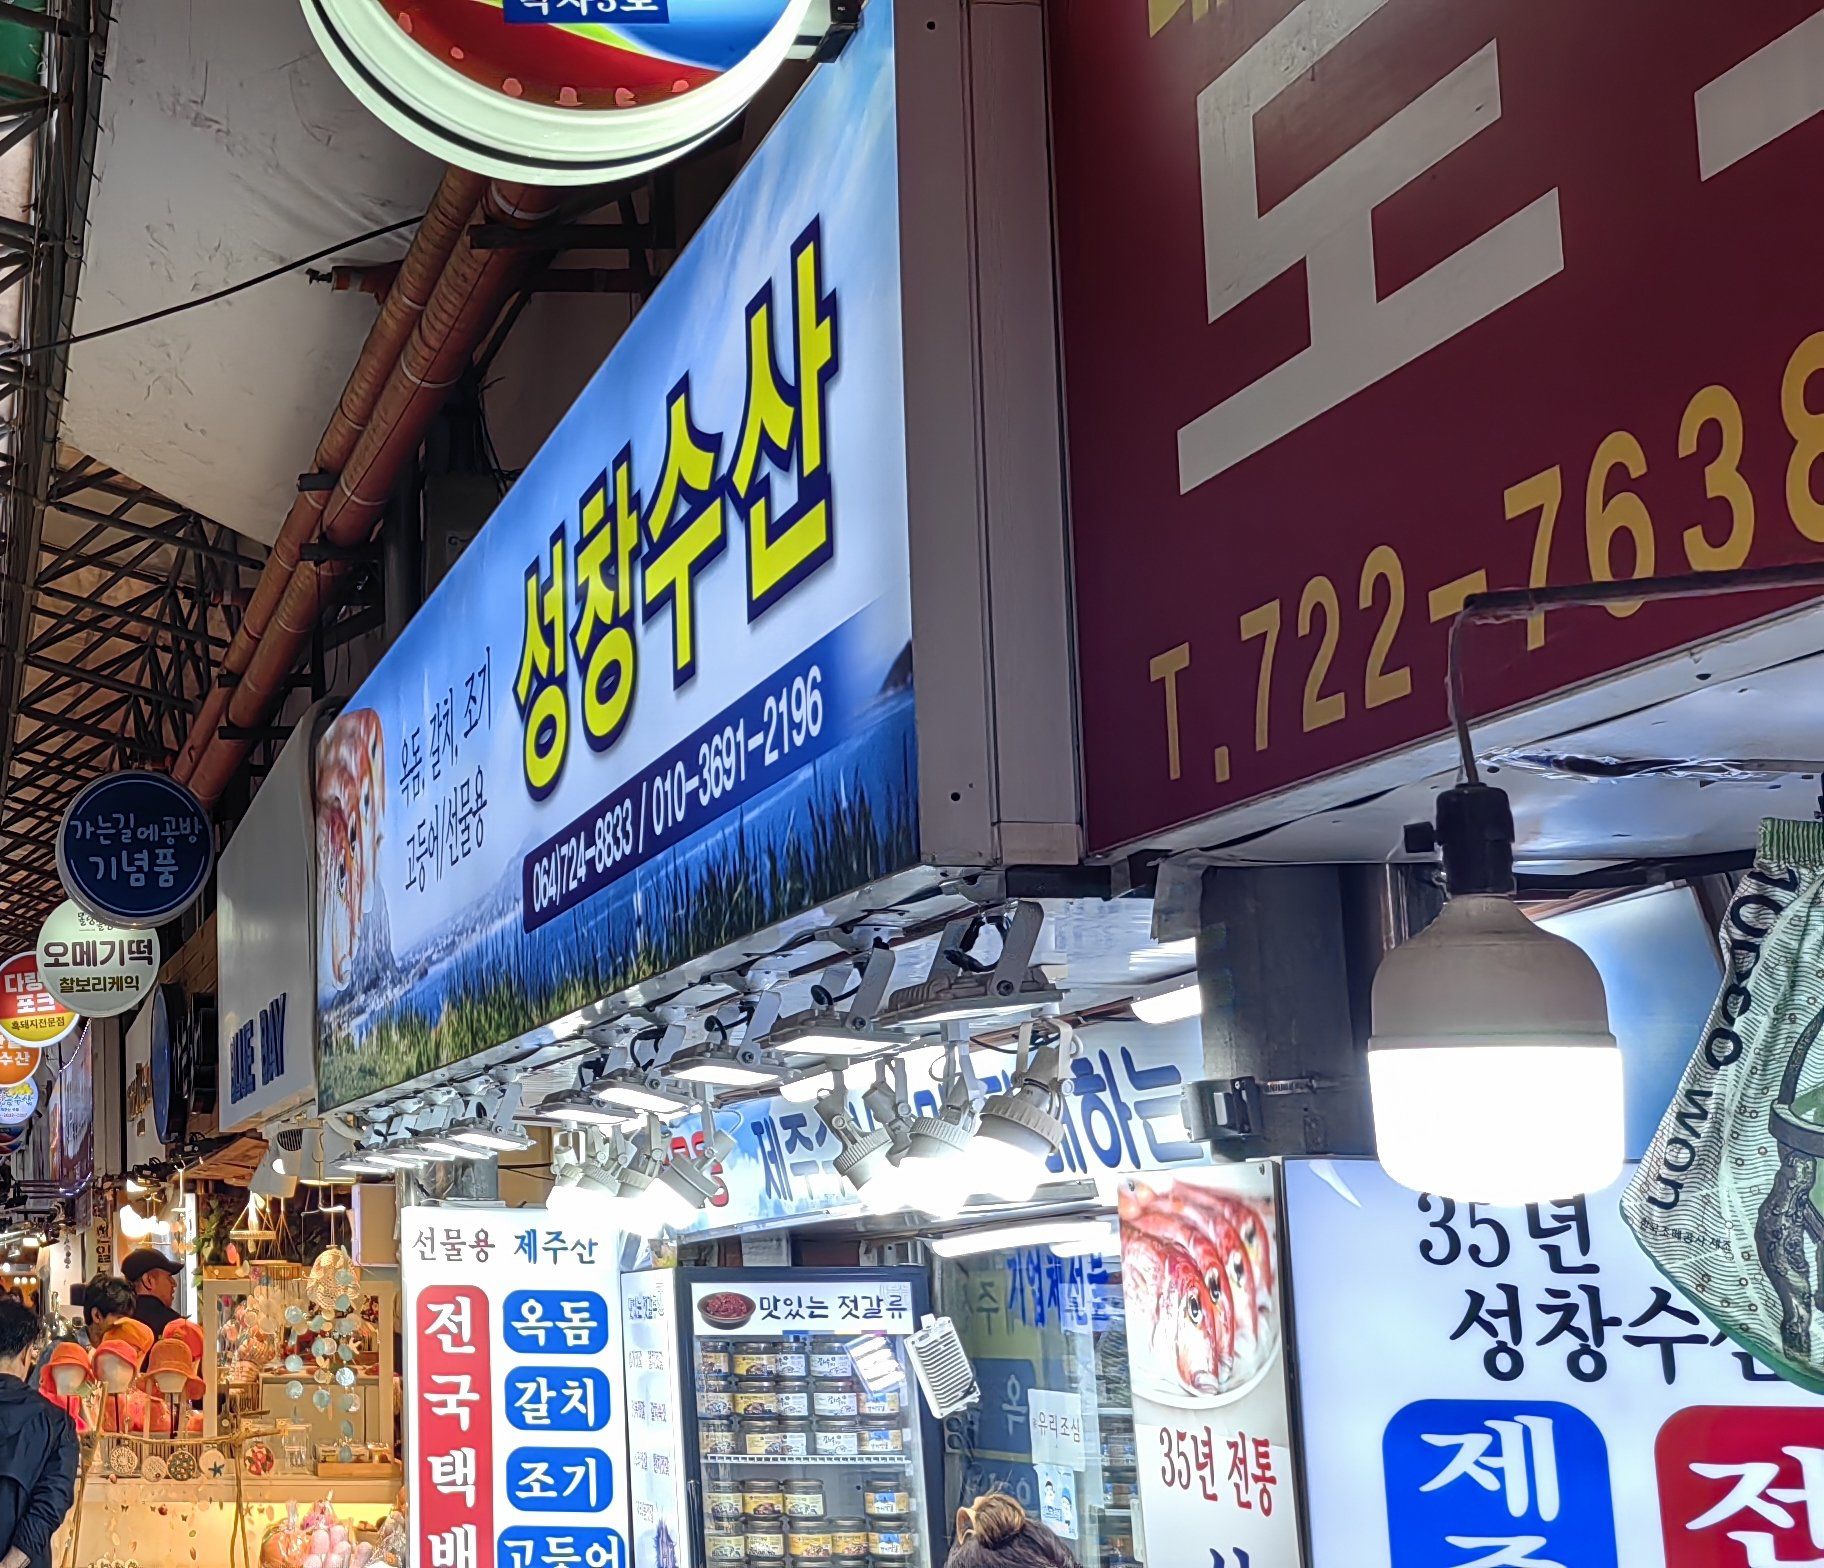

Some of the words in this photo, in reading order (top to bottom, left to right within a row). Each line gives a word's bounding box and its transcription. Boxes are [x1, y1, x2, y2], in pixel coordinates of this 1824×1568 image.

[514, 215, 838, 800] 성창수산
[398, 727, 426, 808] 옥돔,
[429, 687, 459, 782] 갈치,
[463, 645, 492, 739] 조기
[532, 798, 634, 914] 064)724-8833
[651, 664, 824, 837] 010-3691-2196
[404, 764, 488, 894] 고등어/선물용
[88, 848, 179, 887] 기념품
[43, 939, 153, 968] 오메기떡
[4, 973, 43, 993] 다랑
[16, 994, 57, 1013] 포크
[59, 976, 140, 993] 찰보리케익
[11, 1017, 66, 1031] 흑돼지전문점
[259, 992, 287, 1086] BAY
[412, 1227, 496, 1264] 선물용
[512, 1229, 599, 1265] 제주산
[510, 1298, 599, 1348] 옥돔
[760, 1295, 829, 1321] 맛있는
[837, 1295, 908, 1320] 젓갈류
[512, 1376, 596, 1429] 갈치
[515, 1457, 599, 1507] 조기
[1159, 1425, 1218, 1502] 35년
[1226, 1431, 1277, 1517] 전통
